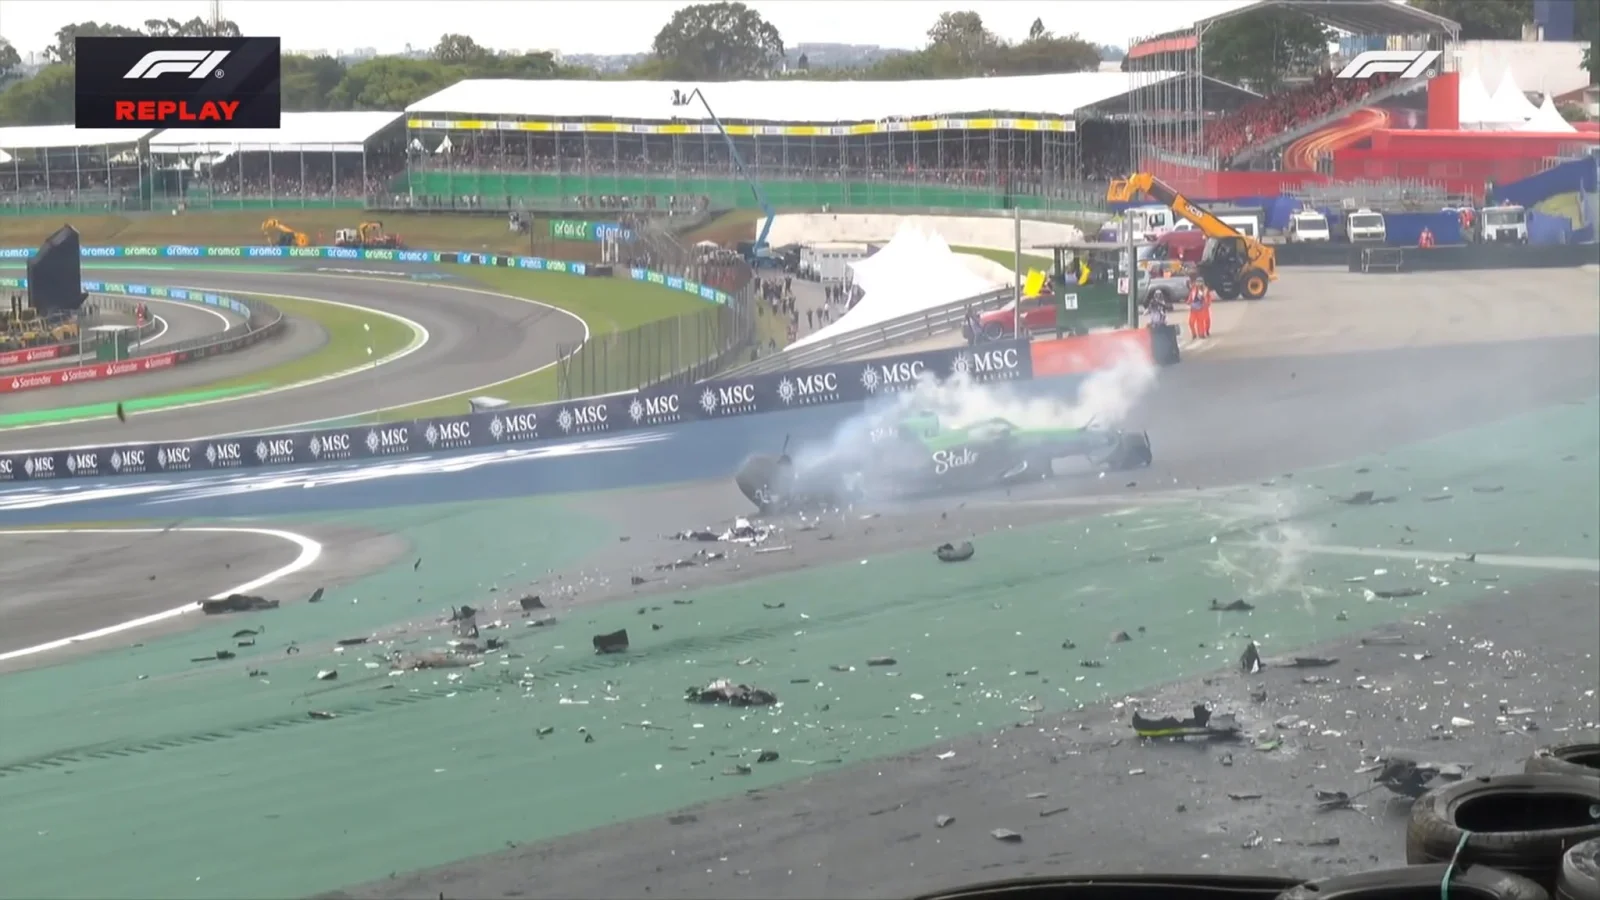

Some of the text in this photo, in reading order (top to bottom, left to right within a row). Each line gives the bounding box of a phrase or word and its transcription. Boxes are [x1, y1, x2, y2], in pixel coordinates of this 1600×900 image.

[0, 248, 29, 257] ramco
[81, 247, 115, 256] aramco
[125, 247, 157, 256] aramco
[167, 246, 199, 256] aramco
[208, 247, 240, 256] aramco
[250, 247, 282, 256] aramco
[290, 248, 320, 257] aramco
[328, 249, 357, 258] aramco
[365, 250, 392, 260] aramco
[974, 349, 1018, 372] MSC
[69, 370, 97, 382] Santander
[882, 361, 924, 384] MSC
[20, 375, 52, 388] Santander
[797, 373, 838, 395] MSC
[720, 384, 755, 406] MSC
[645, 394, 679, 415] MSC
[574, 404, 607, 425] MSC
[439, 421, 470, 441] MSC
[506, 414, 537, 433] MSC
[321, 434, 350, 451] MSC
[381, 428, 409, 445] MSC
[167, 447, 191, 463] MSC
[217, 444, 241, 460] MSC
[269, 439, 294, 455] MSC
[0, 459, 13, 473] SC
[34, 457, 55, 471] MSC
[76, 454, 98, 468] MSC
[122, 450, 145, 466] MSC
[932, 448, 979, 474] Stake
